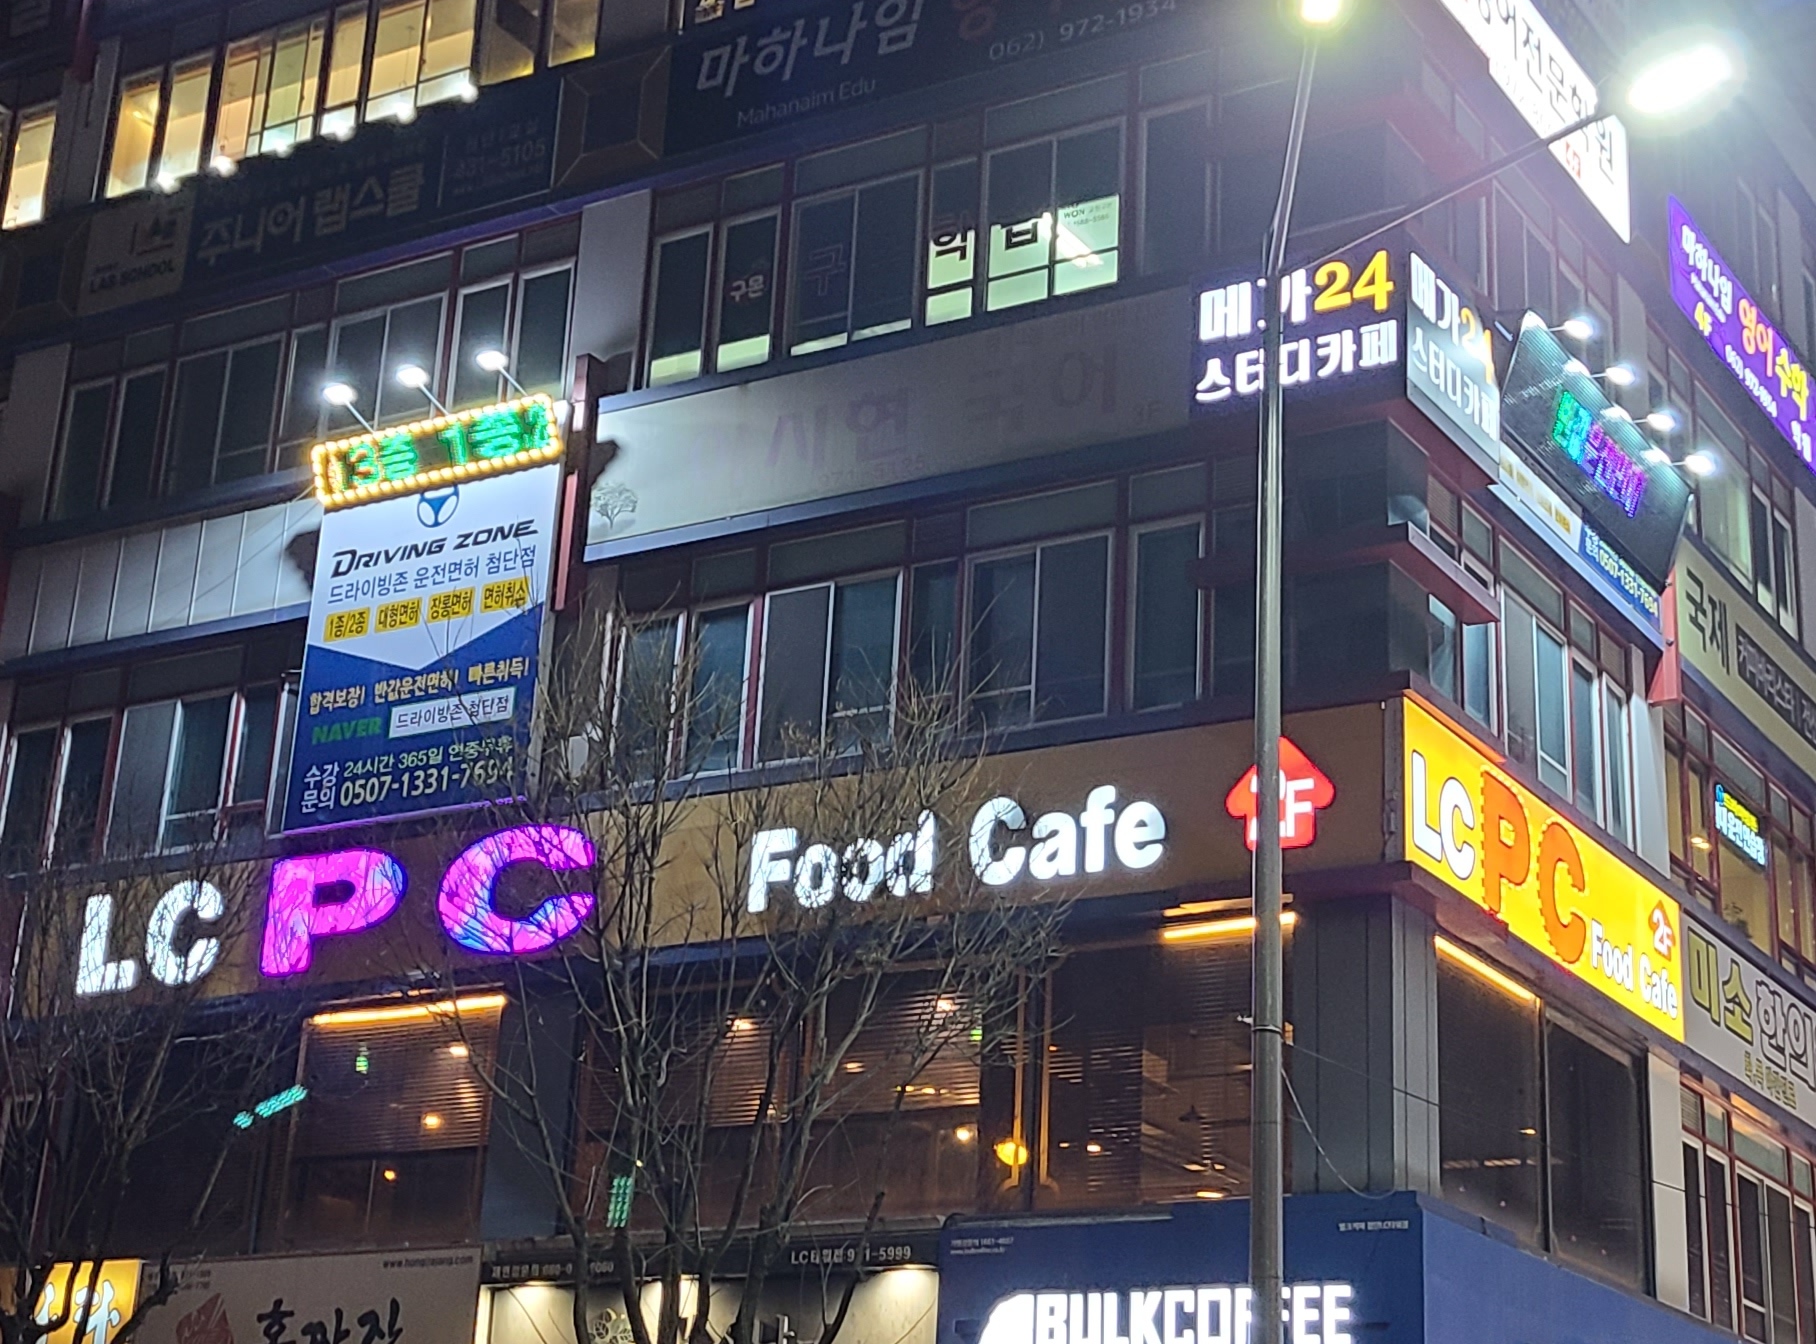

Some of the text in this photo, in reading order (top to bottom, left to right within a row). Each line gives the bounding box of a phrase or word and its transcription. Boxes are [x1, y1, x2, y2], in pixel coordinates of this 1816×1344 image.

[737, 75, 877, 129] Mahanaim Edu
[197, 161, 425, 267] 주니어 랩스쿨
[1737, 298, 1774, 378] 영어
[1412, 326, 1499, 443] 스터디카페
[327, 543, 538, 605] 드라이빙존 운전면허 첨단점
[331, 518, 540, 580] DRIVING ZONE
[328, 578, 529, 641] 1종/2종 대형면허 장롱면허 면허취소
[1685, 567, 1730, 676] 국제
[311, 716, 382, 745] NAVER
[394, 703, 464, 729] 드라이빙존
[303, 764, 340, 789] 수강
[344, 755, 395, 778] 24시간
[398, 745, 444, 767] 365일
[301, 788, 336, 814] 문의
[745, 783, 1168, 916] Food Cafe
[75, 822, 597, 997] LC PC
[1411, 748, 1680, 1021] LC PC Food Cafe
[1651, 906, 1674, 954] 2F
[846, 1244, 912, 1262] 91-5999
